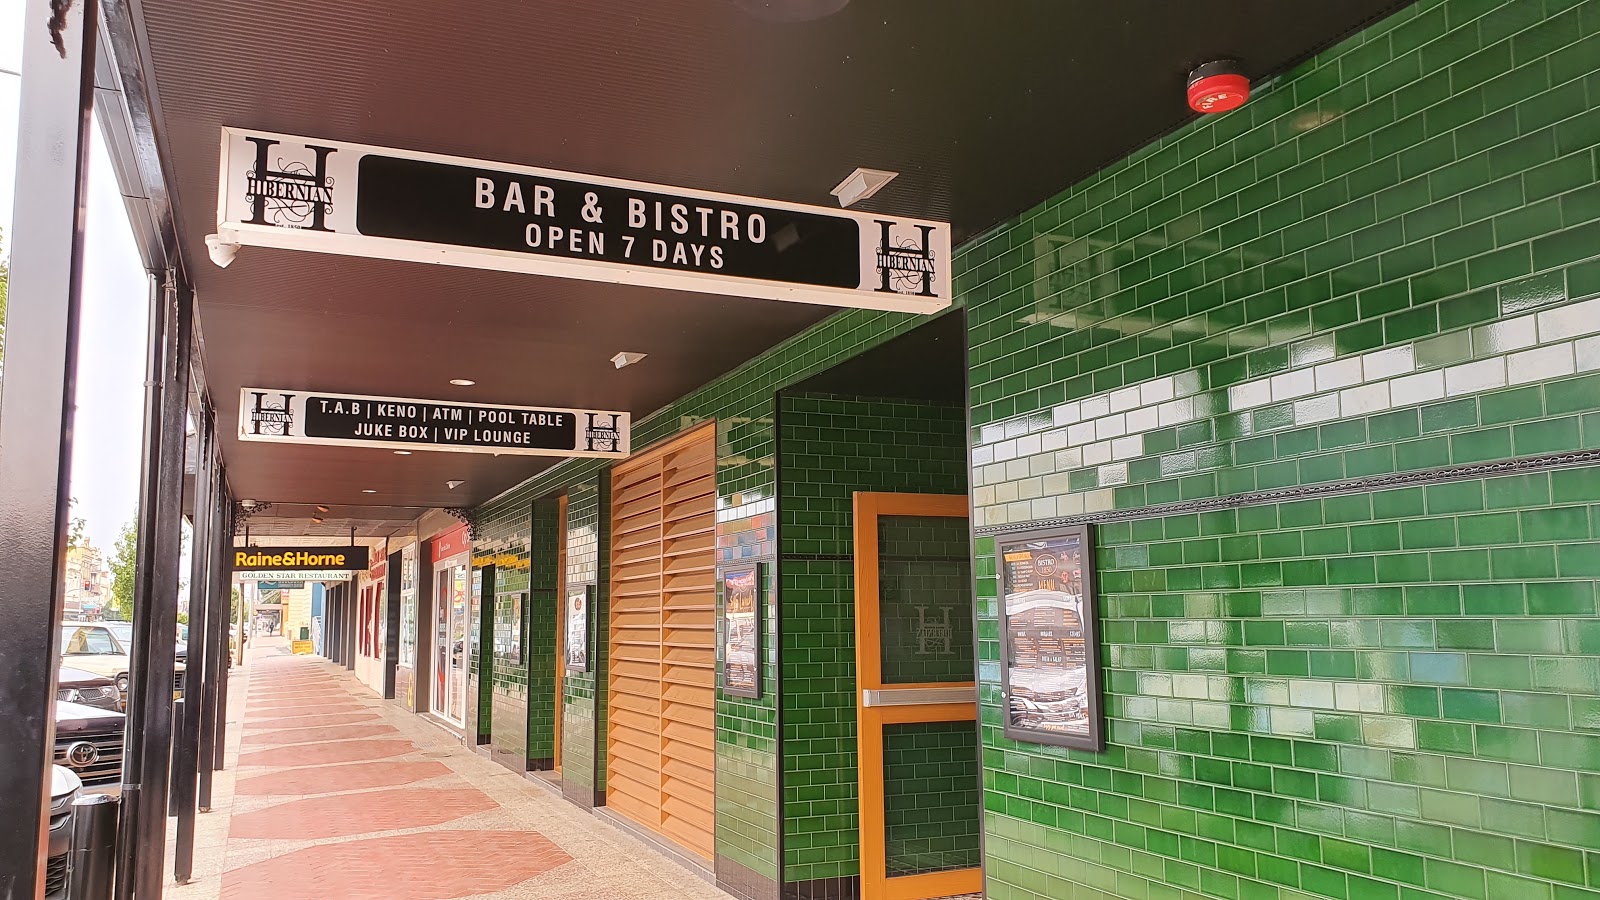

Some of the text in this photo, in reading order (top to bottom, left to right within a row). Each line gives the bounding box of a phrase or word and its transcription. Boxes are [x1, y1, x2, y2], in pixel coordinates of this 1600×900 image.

[246, 177, 334, 206] HIBERNIAN
[475, 177, 766, 244] BAR & BISTRO
[525, 223, 724, 269] OPEN 7 DAYS
[876, 252, 935, 274] HIBERNIAN
[251, 411, 293, 423] HIBERNIAN
[378, 404, 417, 419] KENO
[433, 407, 462, 421] ATM
[479, 410, 516, 424] POOL
[521, 412, 563, 427] TABLE
[354, 422, 393, 437] JUKE
[398, 424, 428, 439] BOX
[444, 427, 468, 441] VIP
[474, 429, 531, 444] LOUNGE
[235, 551, 346, 567] Raine&Horne
[1037, 558, 1055, 567] BISTRO
[1038, 579, 1056, 591] MENU
